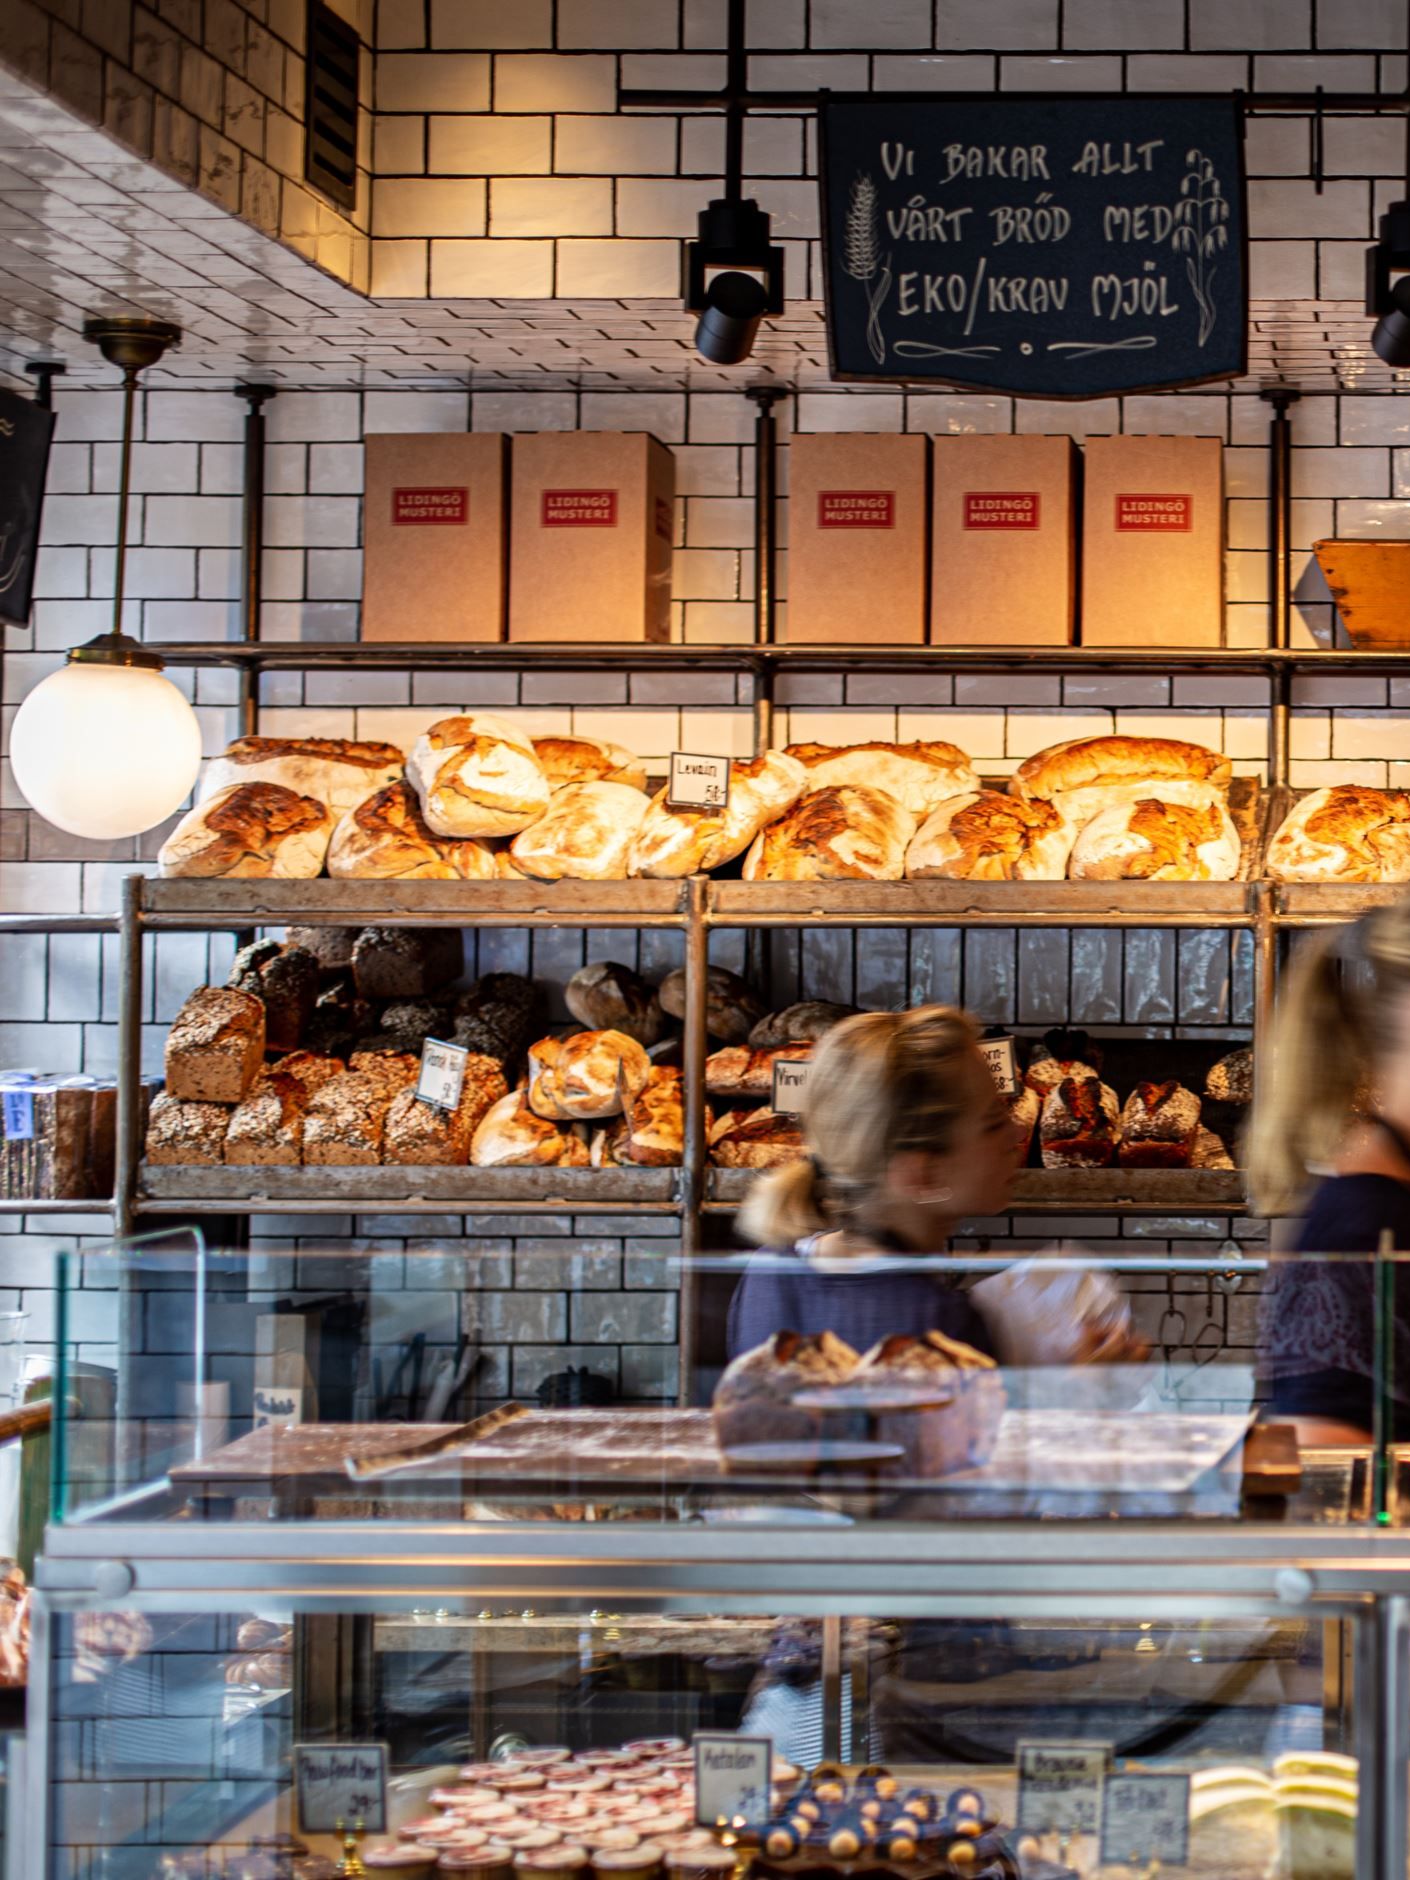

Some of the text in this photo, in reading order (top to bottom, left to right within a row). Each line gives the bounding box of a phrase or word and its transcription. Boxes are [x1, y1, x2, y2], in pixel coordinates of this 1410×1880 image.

[940, 142, 1050, 184] BAKAR
[1072, 140, 1164, 175] ALLT
[887, 192, 1173, 246] VÅRT BRÖD MED
[898, 258, 1179, 336] EKO/KRAV MJÖL
[399, 493, 461, 505] LIDINGÖ
[548, 494, 610, 507] LIDINGÖ
[825, 496, 888, 509] LIDINGÖ
[970, 497, 1033, 510] LIDINGÖ
[1122, 499, 1186, 512] LIDINGÖ
[399, 507, 460, 518] MUSTERI
[548, 509, 609, 519] MUSTERI
[825, 510, 887, 521] MUSTERI
[970, 512, 1032, 522] MUSTERI
[1122, 514, 1185, 525] MUSTERI
